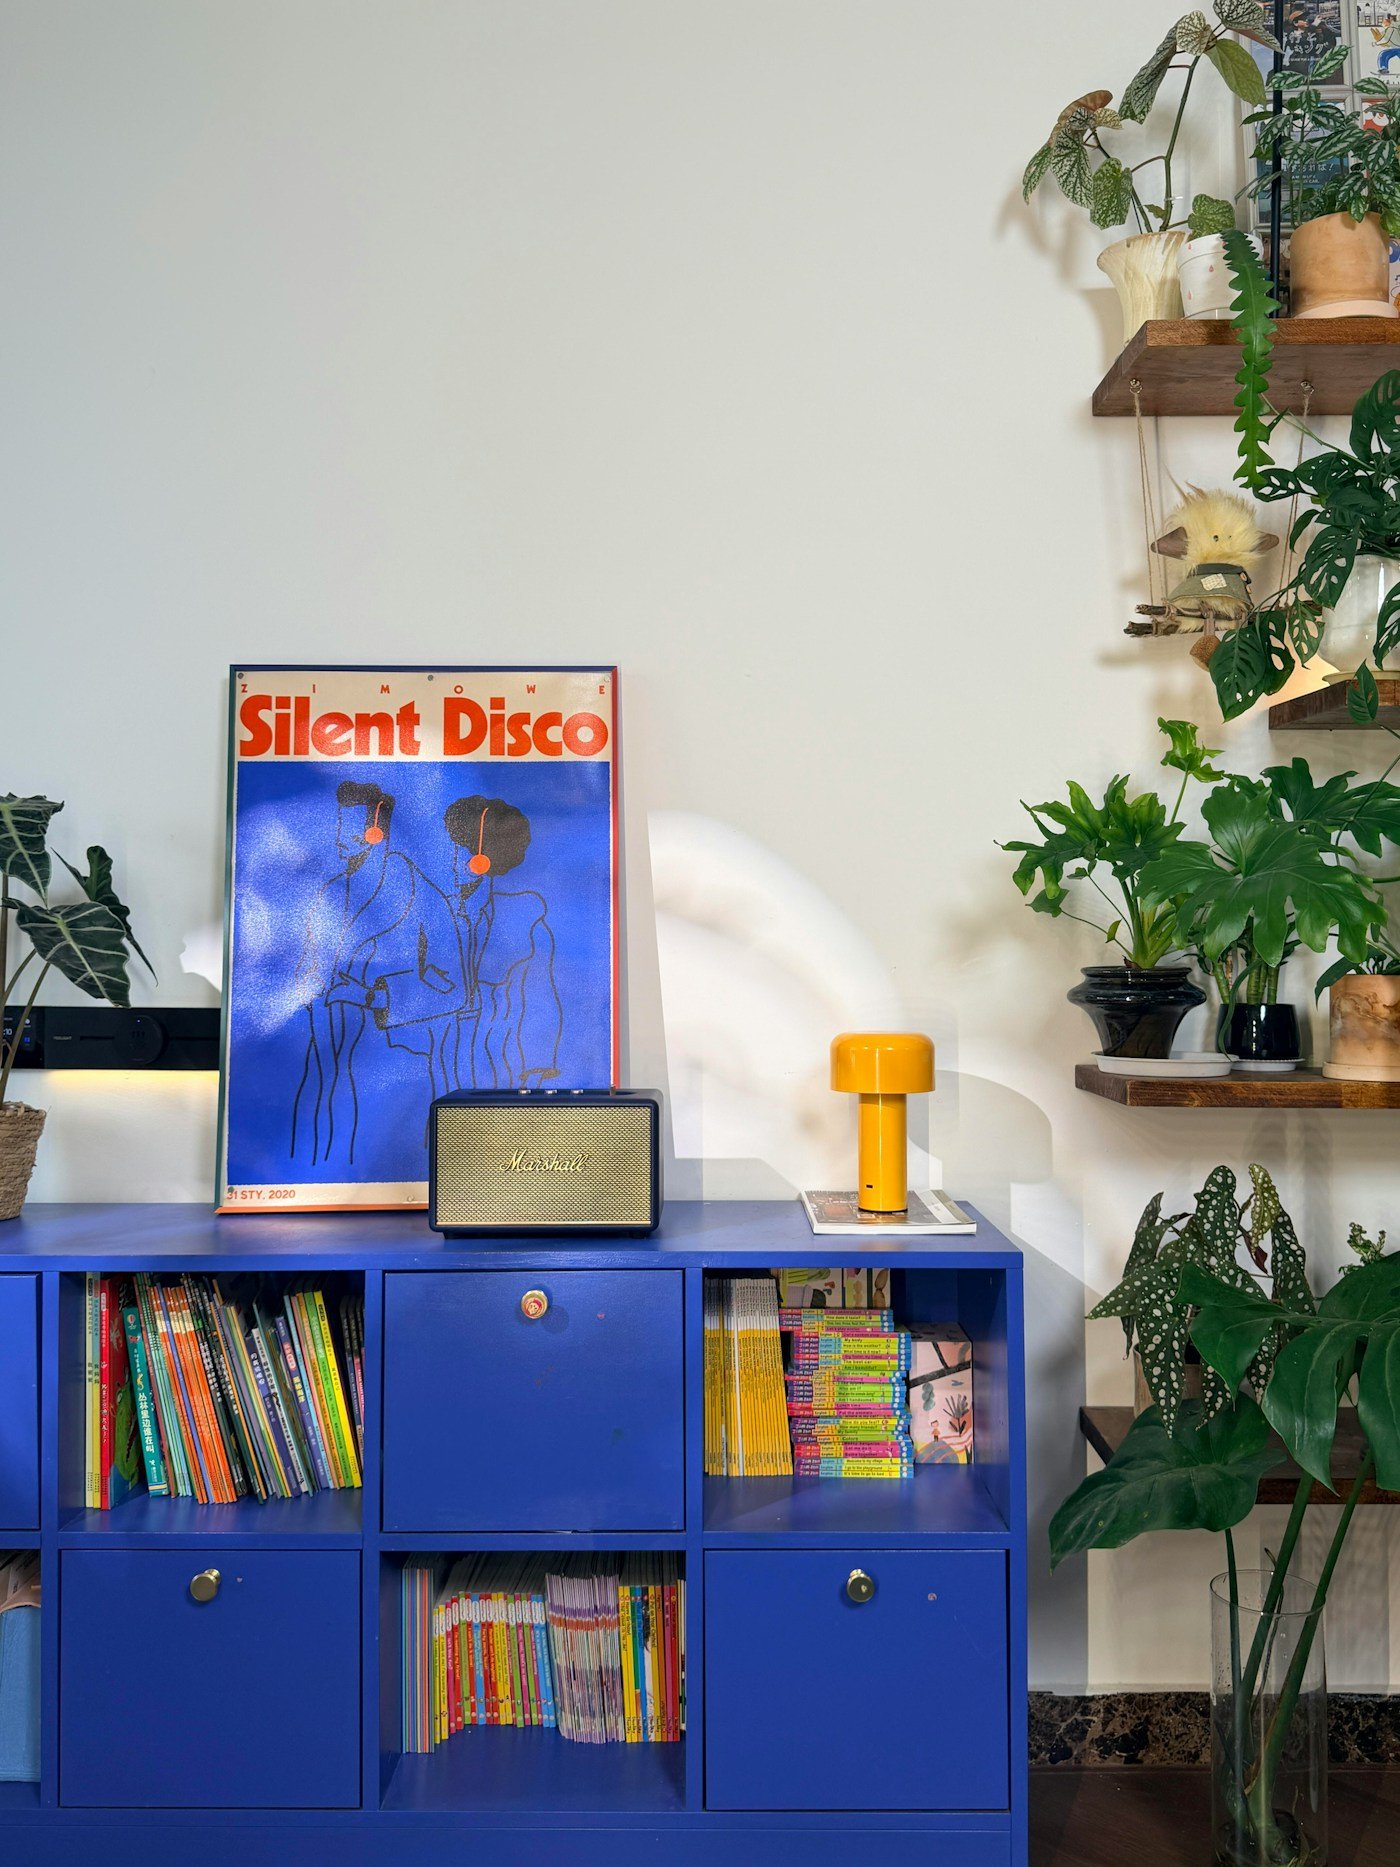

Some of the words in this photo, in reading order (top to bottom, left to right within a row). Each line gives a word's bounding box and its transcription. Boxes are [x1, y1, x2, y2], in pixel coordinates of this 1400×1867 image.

[239, 694, 421, 756] Silent
[443, 696, 609, 757] Disco
[500, 1147, 588, 1173] Marshall
[268, 1188, 296, 1200] 2020
[138, 1392, 155, 1454] 丛林里边谁在叫
